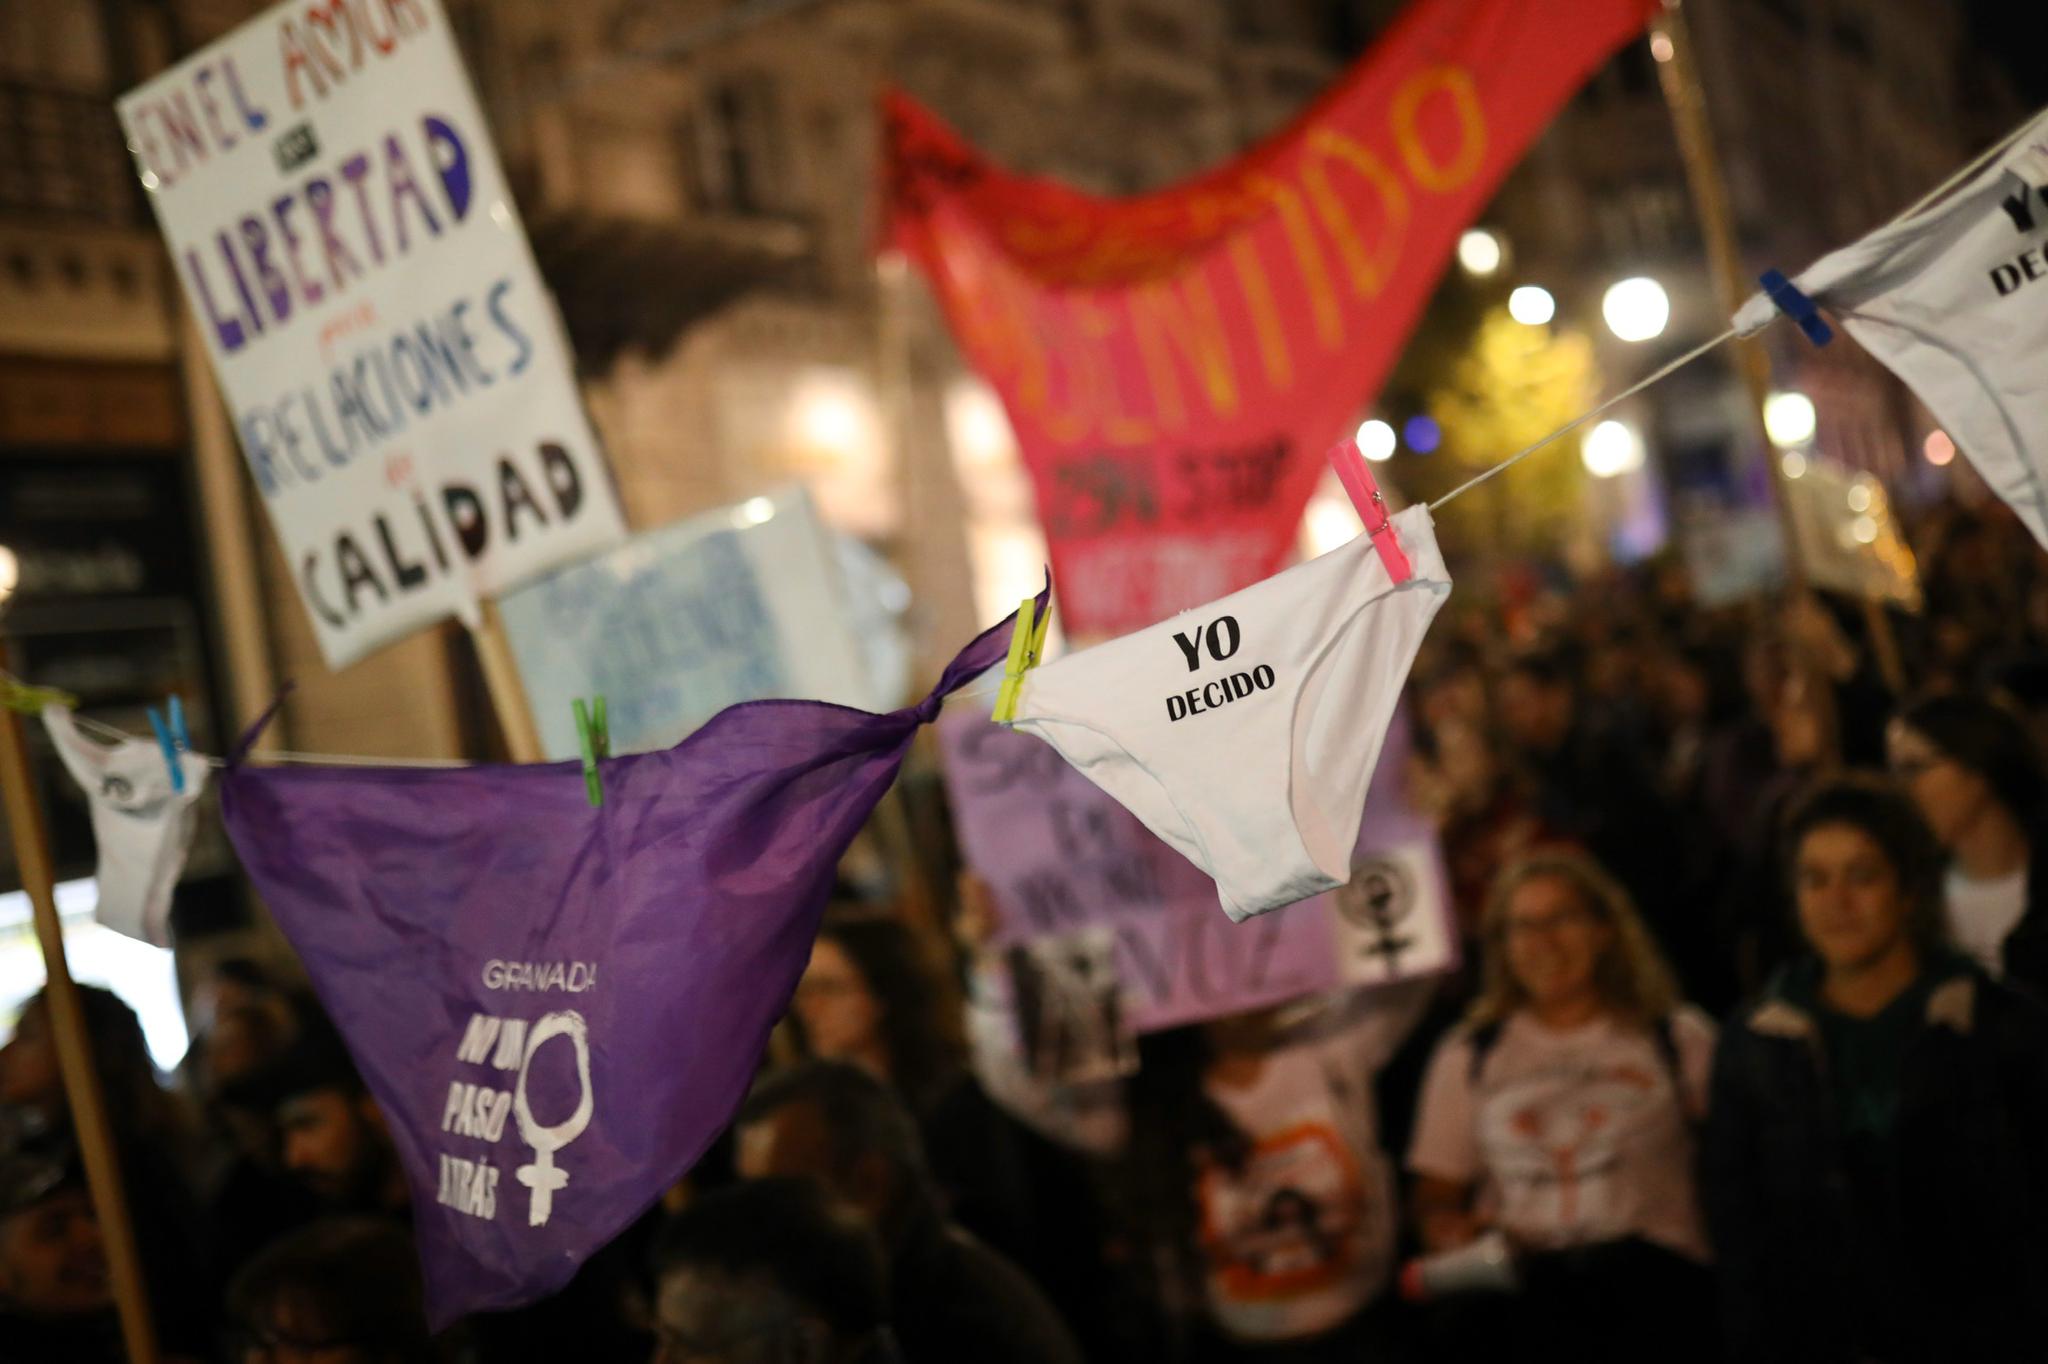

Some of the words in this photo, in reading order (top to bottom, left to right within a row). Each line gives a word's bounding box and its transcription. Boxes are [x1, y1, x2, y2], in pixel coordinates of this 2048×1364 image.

[186, 114, 473, 353] LIBERTAD
[238, 278, 534, 495] RELACIONES
[302, 440, 586, 629] CALIDAD
[1166, 664, 1275, 722] DECIDO
[1172, 615, 1241, 672] YO
[442, 1081, 513, 1143] PASO
